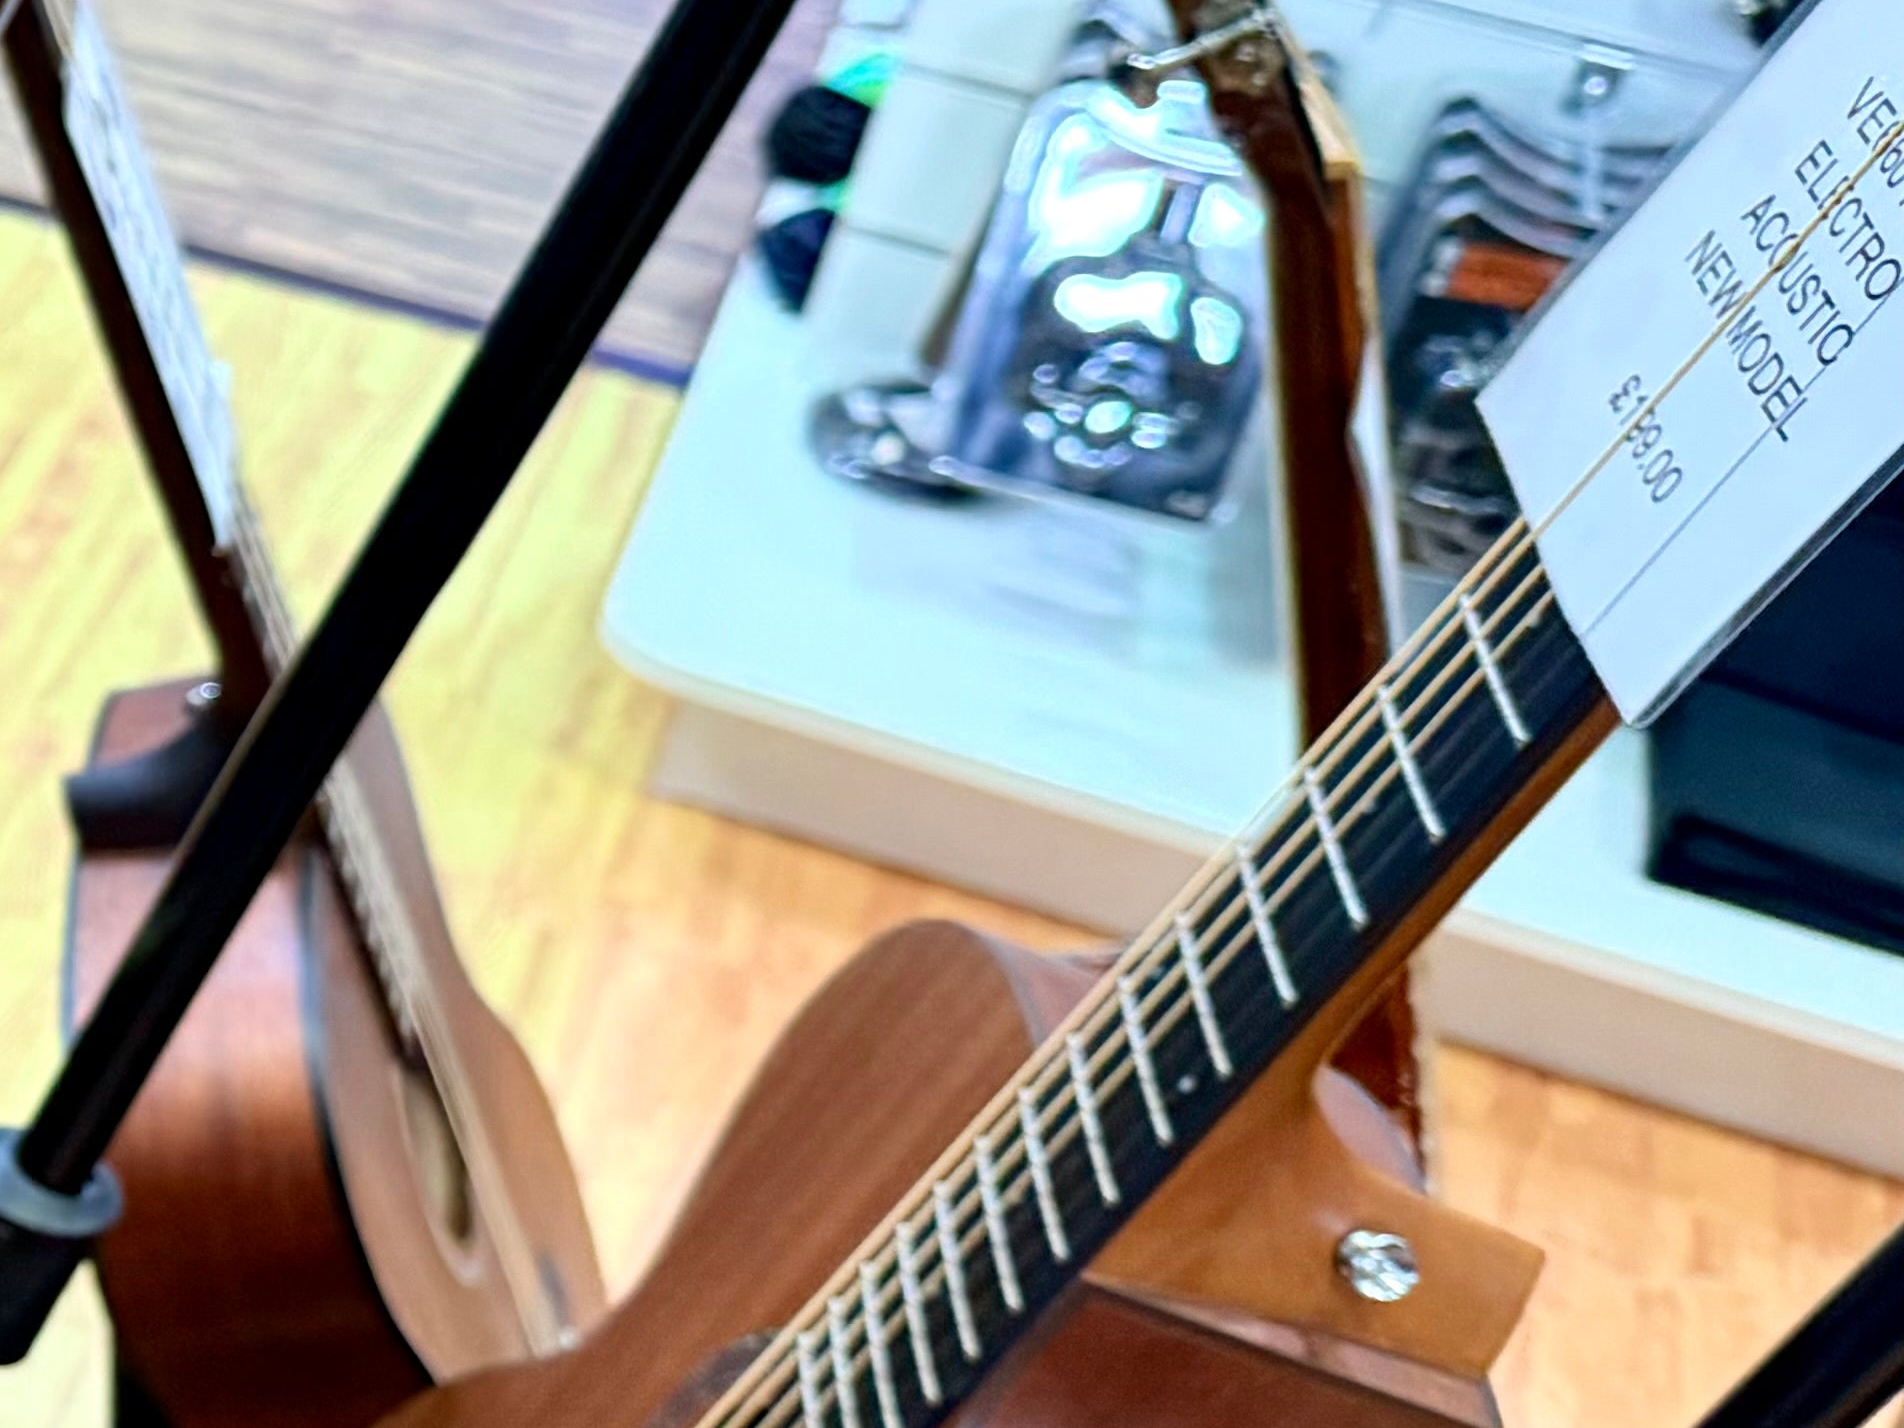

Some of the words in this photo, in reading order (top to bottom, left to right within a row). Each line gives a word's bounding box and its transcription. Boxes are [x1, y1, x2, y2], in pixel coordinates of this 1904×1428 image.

[1795, 139, 1902, 301] ELECTRO
[1684, 229, 1751, 320] NEW
[1726, 305, 1808, 442] MODEL
